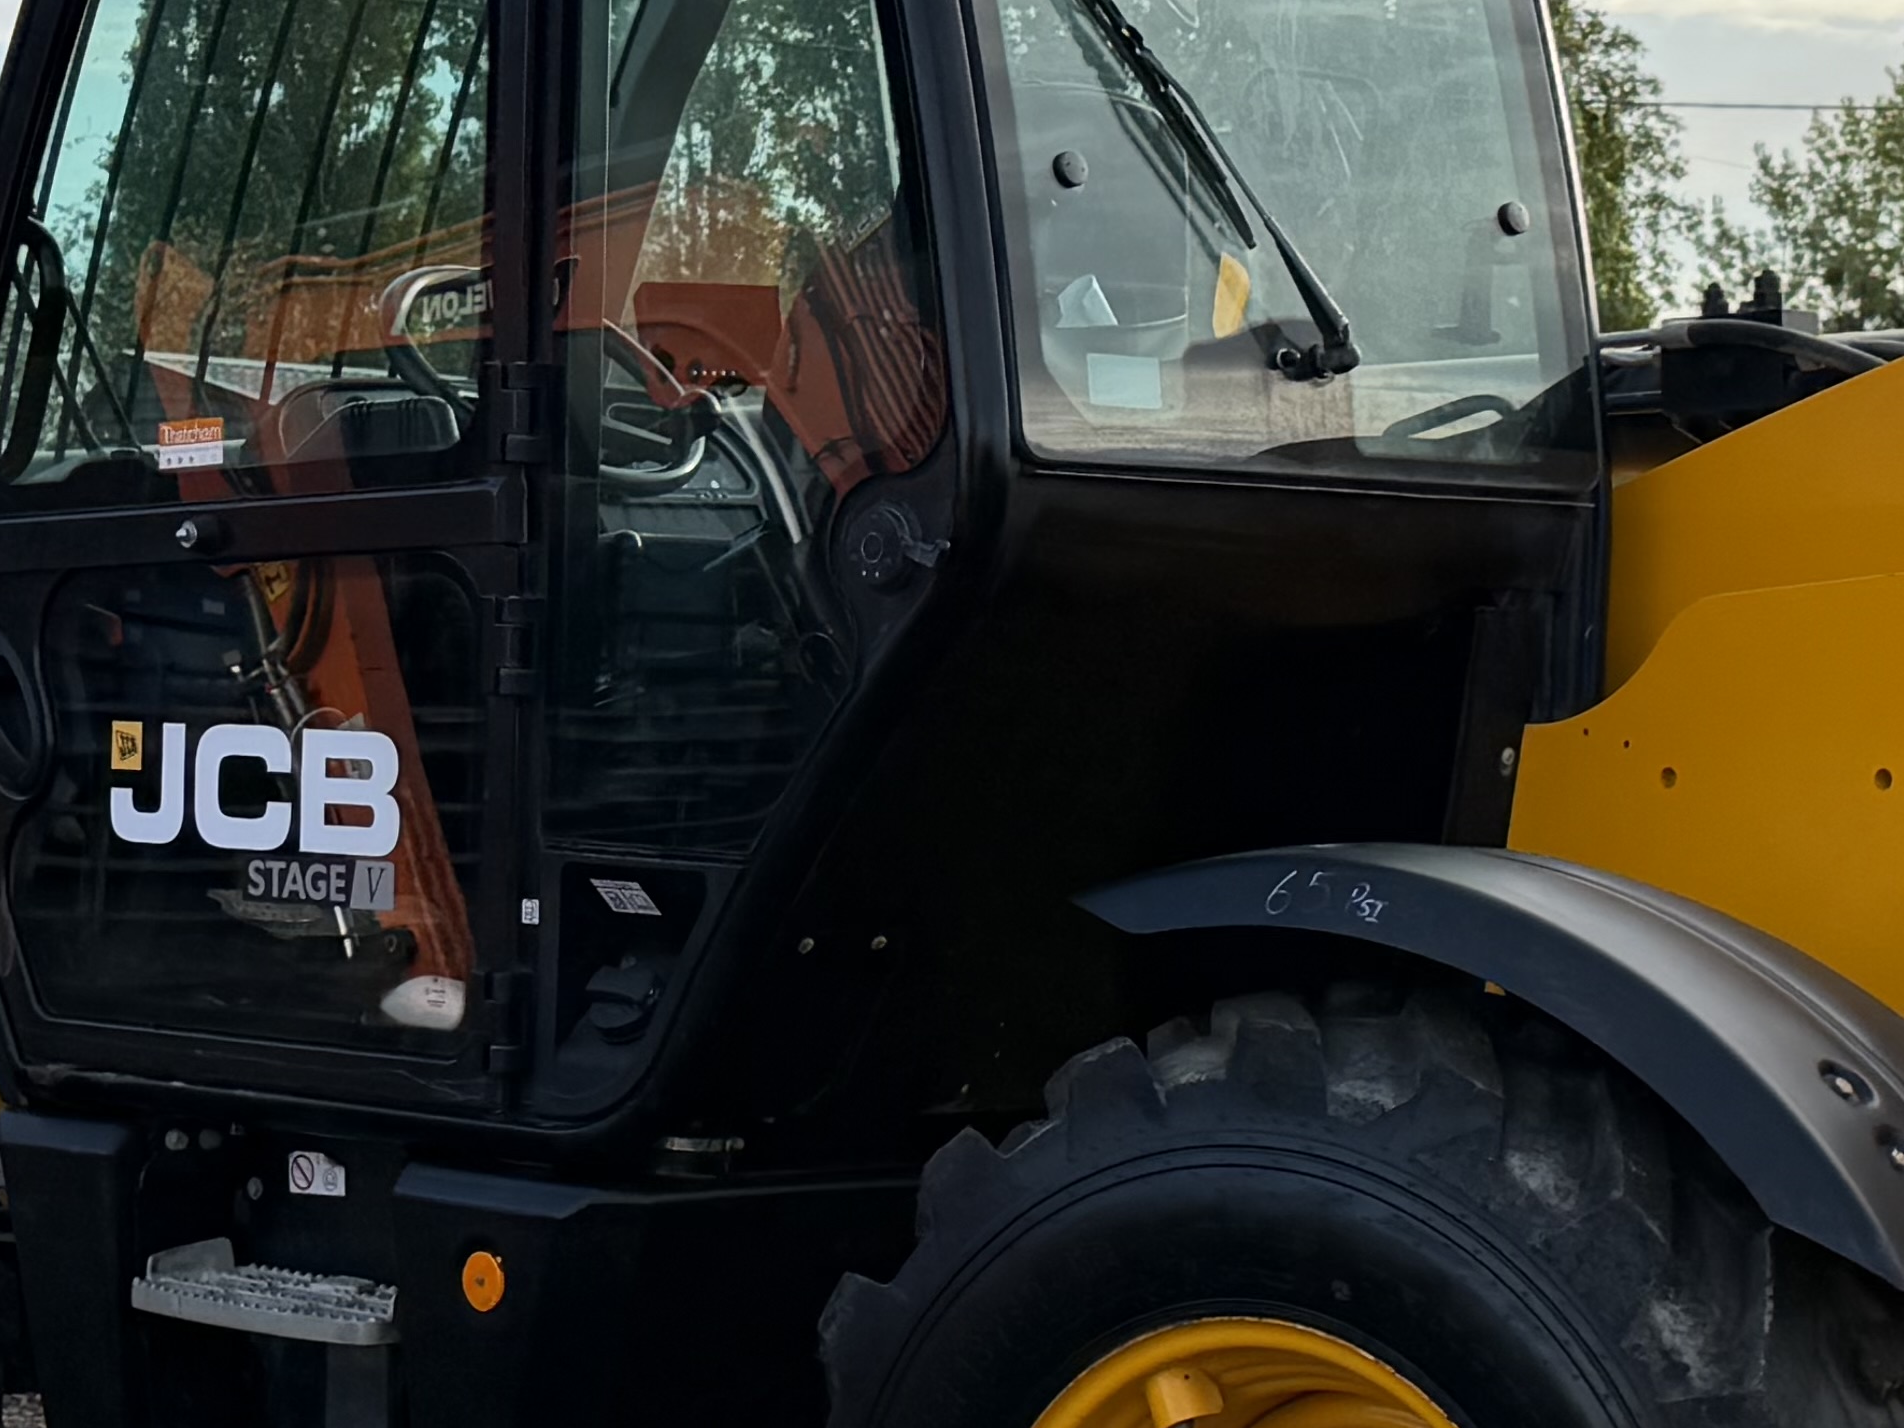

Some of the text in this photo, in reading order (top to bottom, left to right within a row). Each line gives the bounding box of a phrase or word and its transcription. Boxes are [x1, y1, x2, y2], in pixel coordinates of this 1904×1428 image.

[110, 722, 400, 857] JCB
[247, 859, 385, 903] STAGE V
